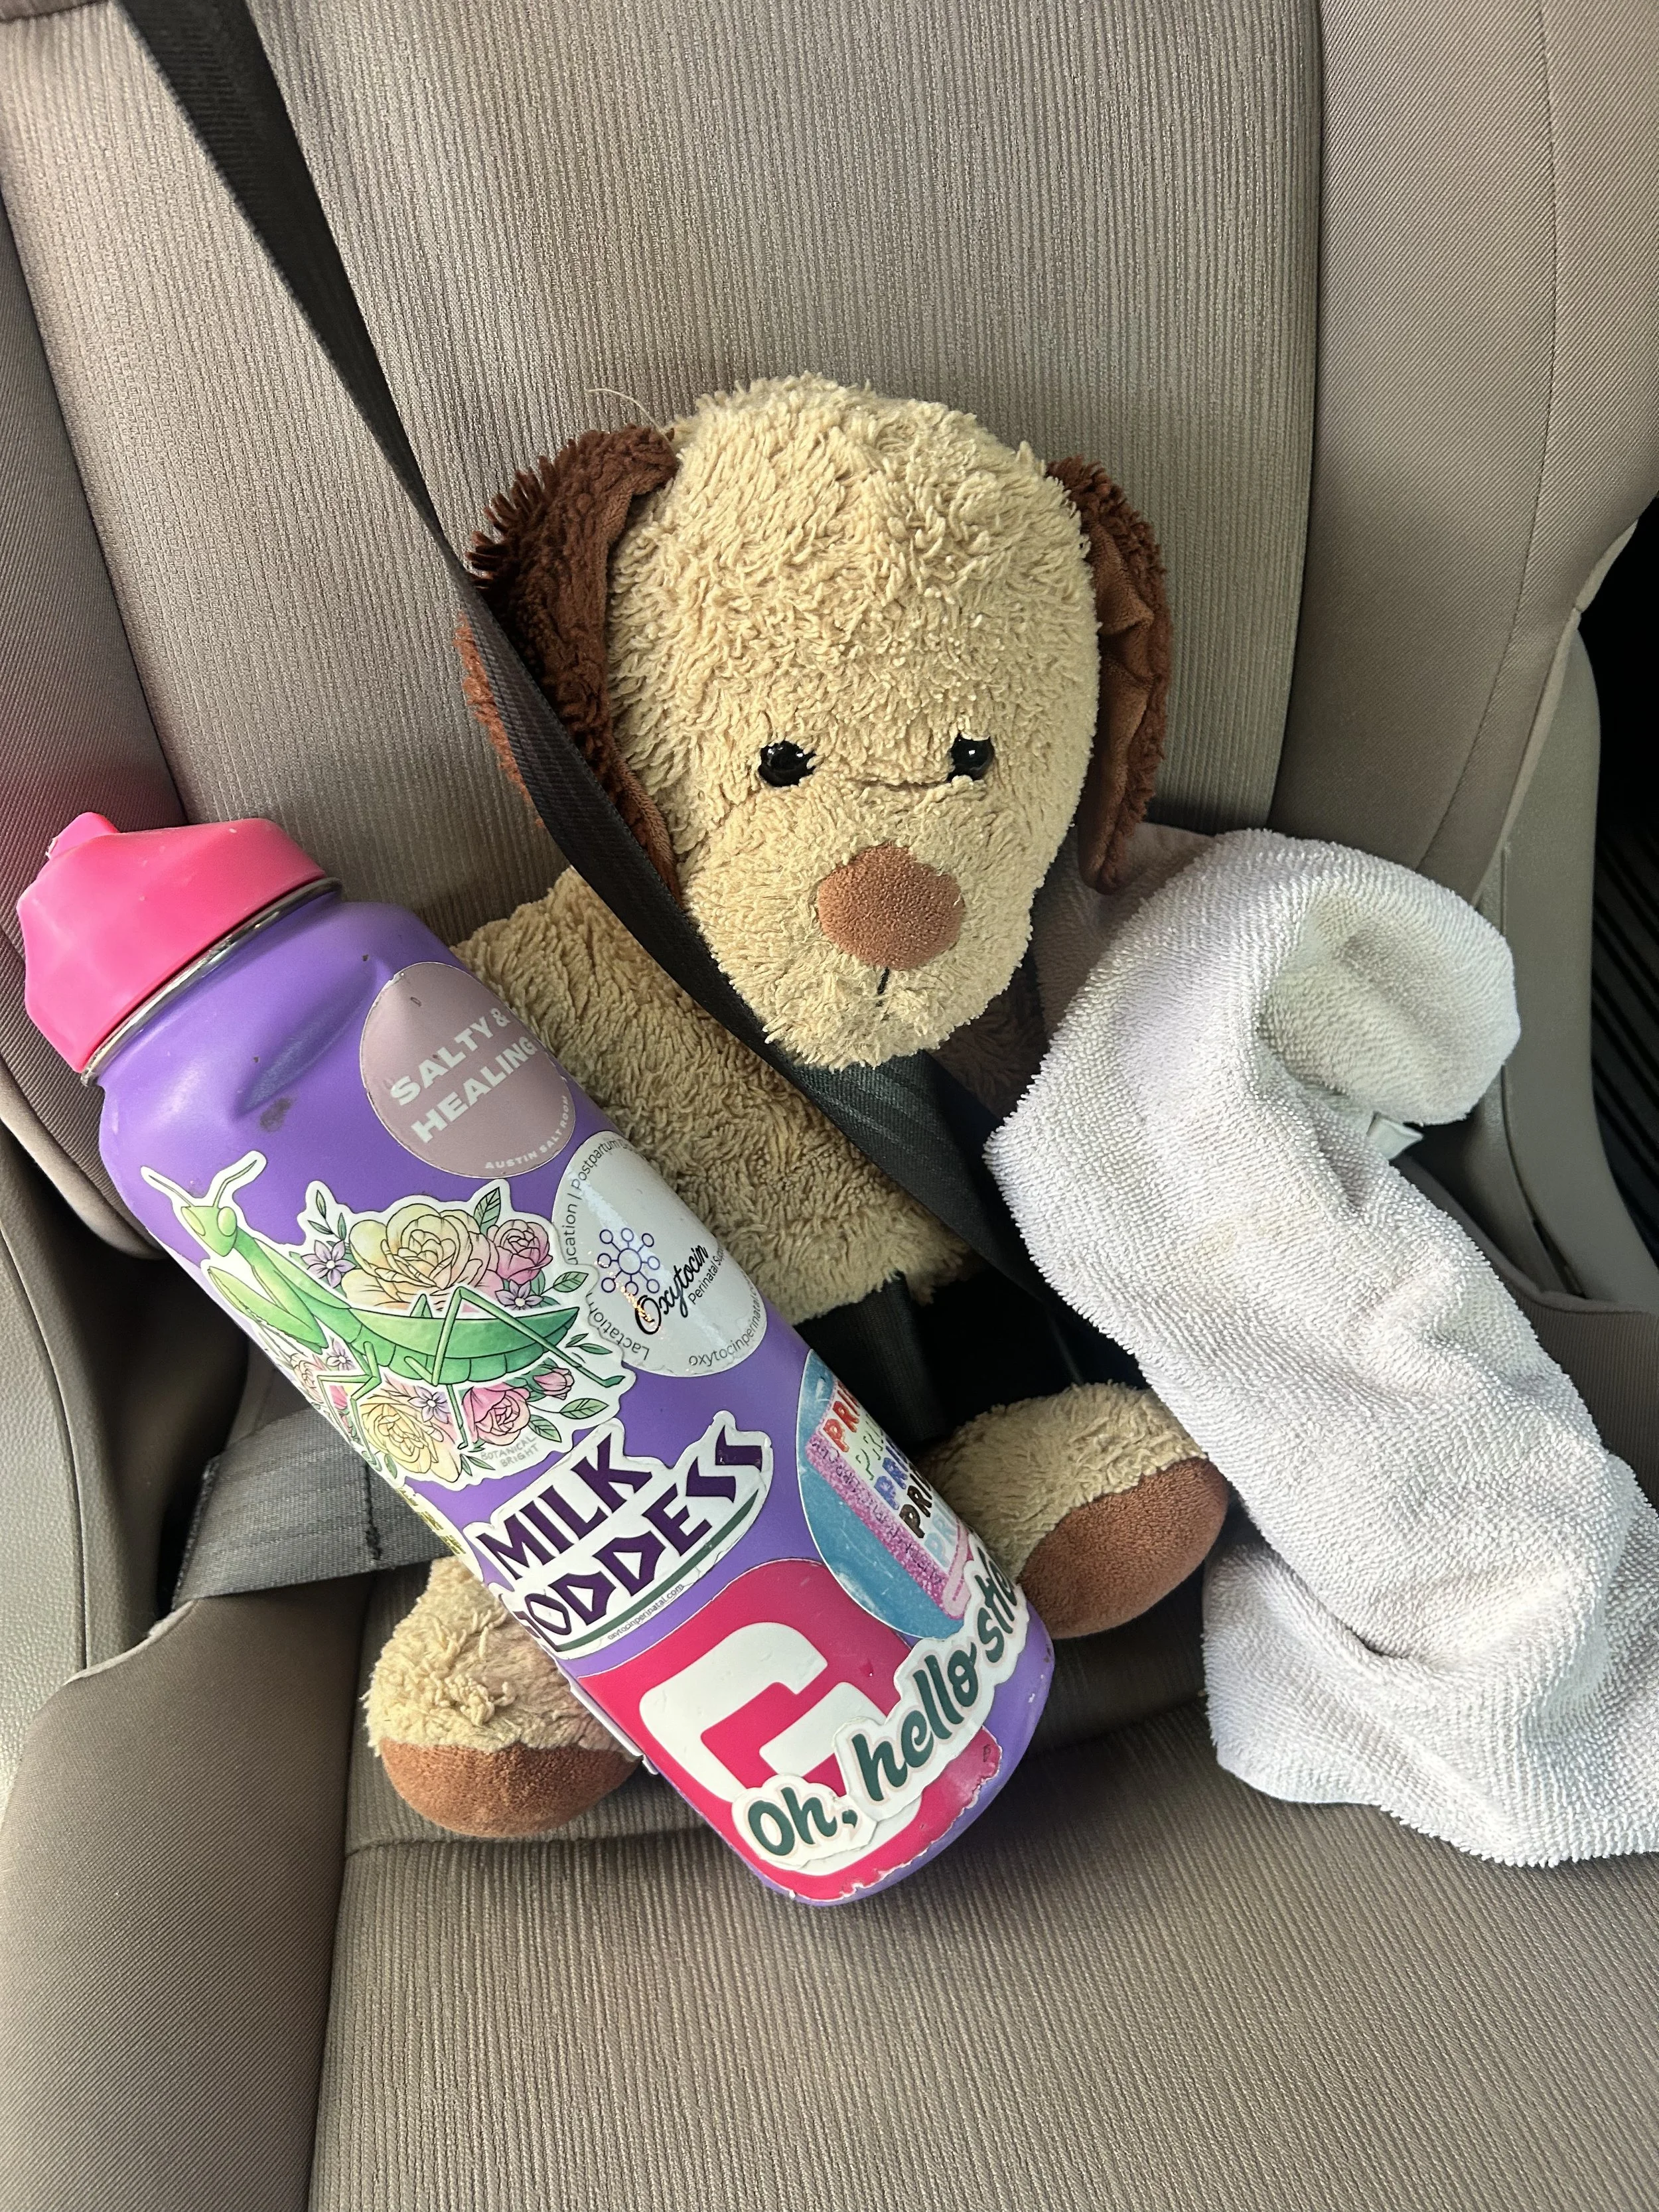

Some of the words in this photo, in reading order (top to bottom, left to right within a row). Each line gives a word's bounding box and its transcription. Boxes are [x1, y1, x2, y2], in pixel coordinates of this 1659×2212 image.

[390, 1017, 494, 1106] SALTY
[490, 1007, 511, 1027] &
[411, 1036, 538, 1143] HEALING
[484, 1151, 538, 1169] AUSTIN
[539, 1128, 563, 1153] SALT
[559, 1095, 569, 1128] ROOM
[635, 1244, 710, 1335] Oxytocin
[687, 1260, 719, 1305] Perinatal
[480, 1436, 538, 1460] BOTANICAL
[500, 1443, 540, 1467] BRIGHT
[475, 1432, 653, 1580] MILK
[514, 1425, 762, 1651] ODDESS
[607, 1583, 685, 1641] oxytocinperinatal.com
[747, 1787, 859, 1857] Oh,
[851, 1642, 979, 1801] hello
